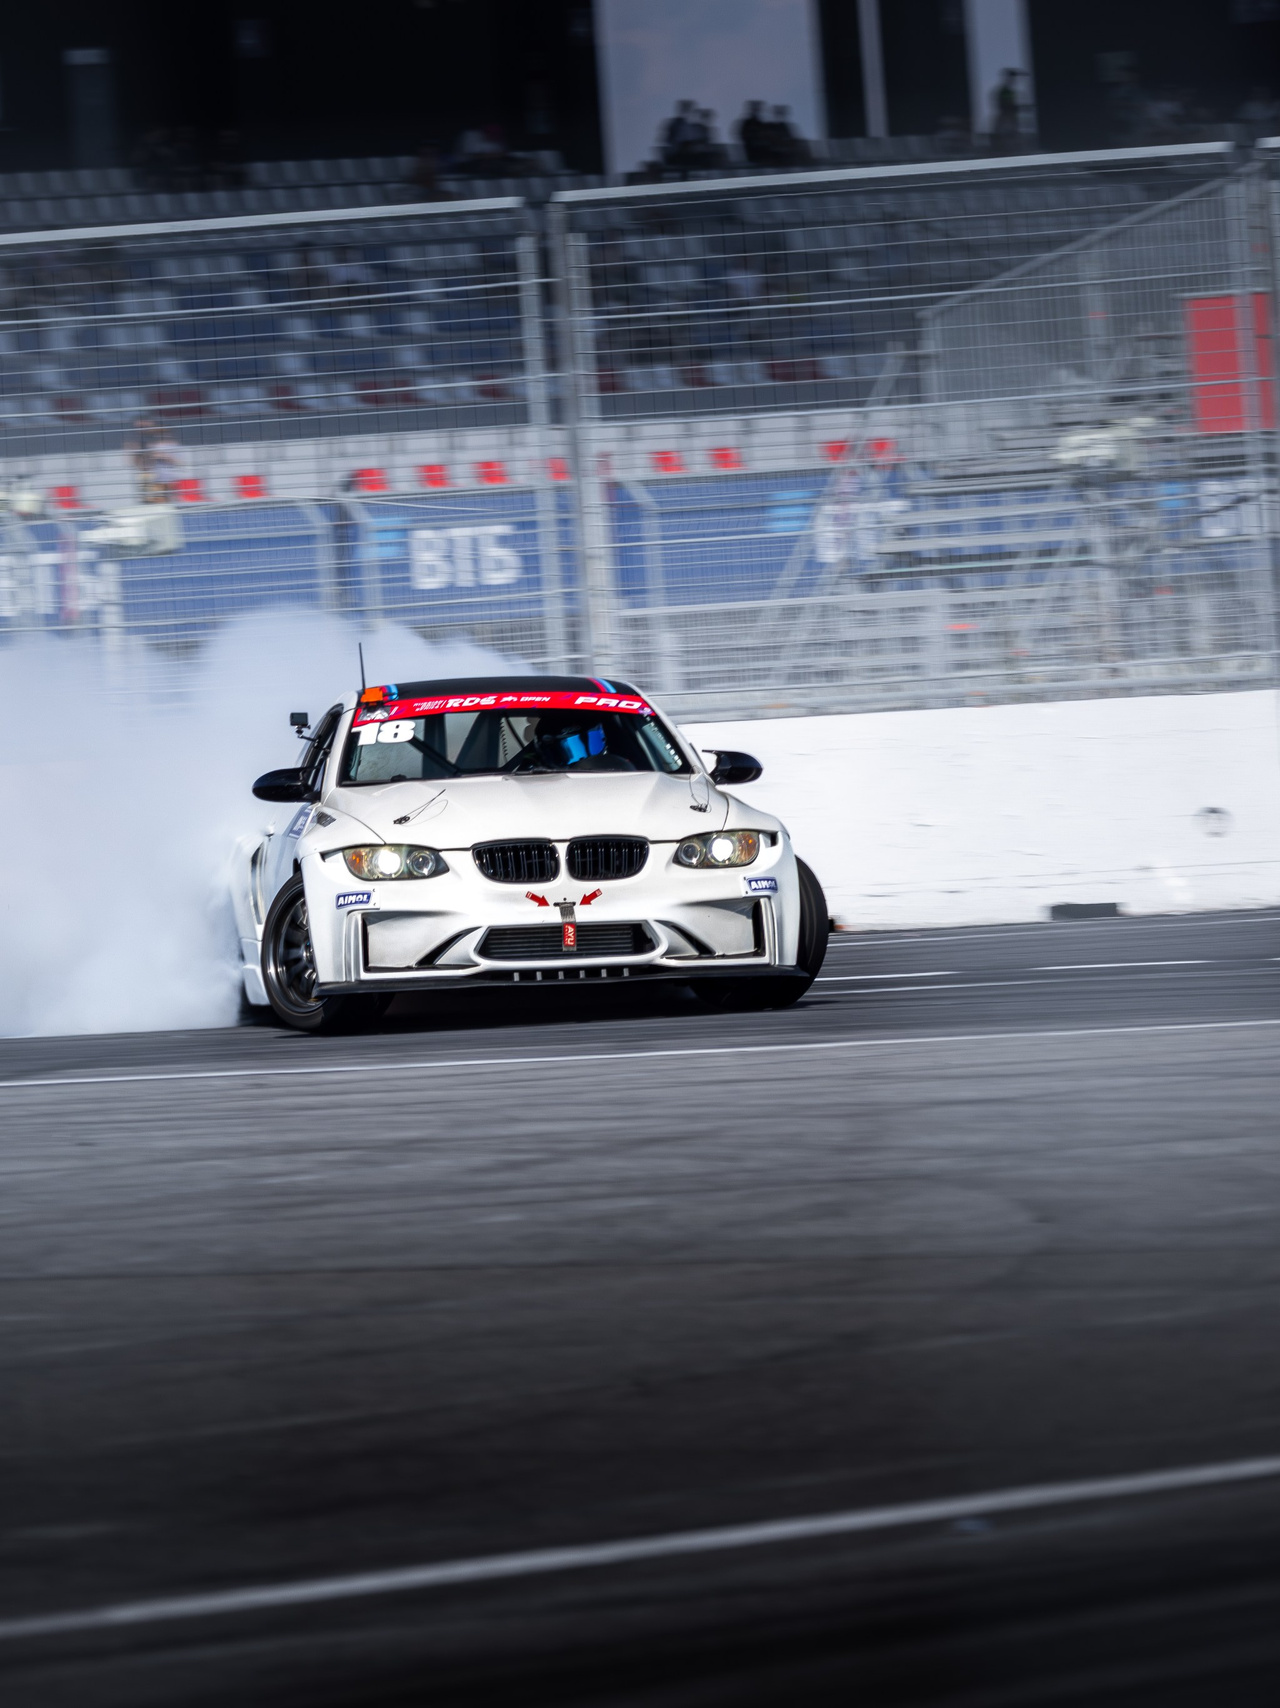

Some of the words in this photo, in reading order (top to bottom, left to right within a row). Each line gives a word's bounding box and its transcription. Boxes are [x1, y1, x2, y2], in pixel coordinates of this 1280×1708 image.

[409, 525, 521, 589] ВТБ
[573, 696, 643, 710] PRO
[351, 720, 417, 747] 18
[337, 894, 369, 907] AIMOL
